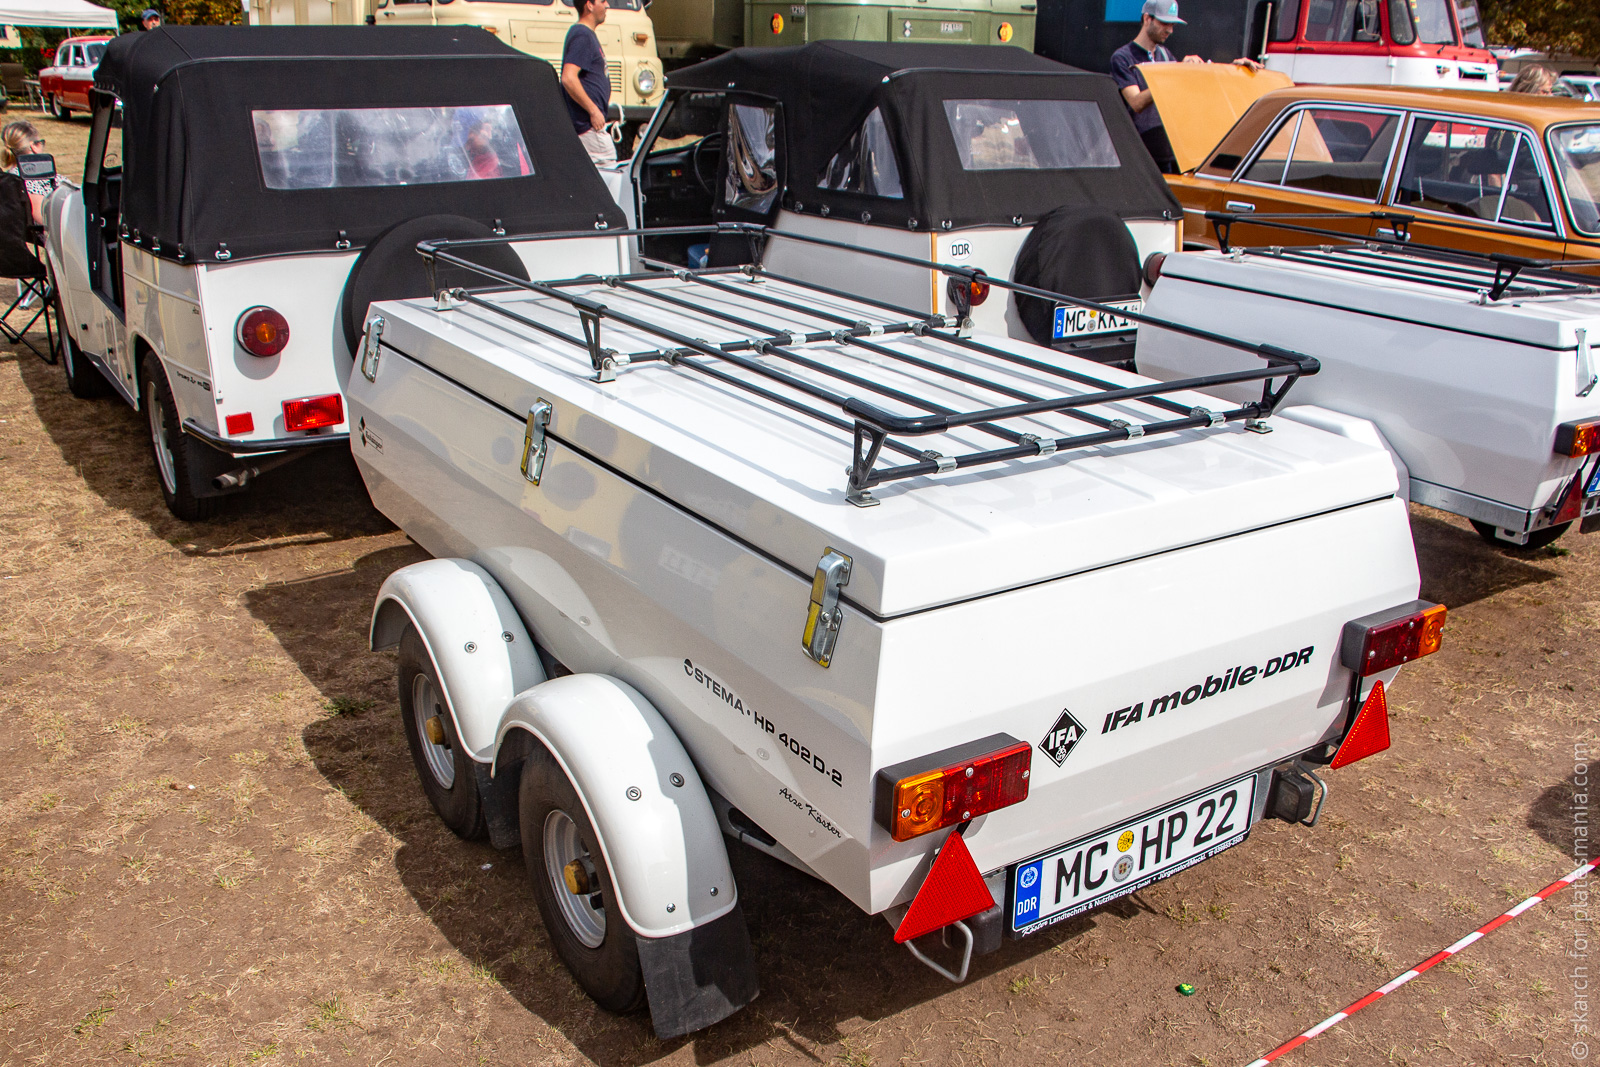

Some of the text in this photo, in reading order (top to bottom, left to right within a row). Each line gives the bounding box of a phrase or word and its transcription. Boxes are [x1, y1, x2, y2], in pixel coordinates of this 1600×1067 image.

[952, 243, 970, 256] DDR
[1065, 310, 1086, 333] MC
[694, 668, 744, 715] STEMA
[754, 711, 775, 734] HP
[1101, 702, 1144, 734] IFA
[1049, 725, 1077, 750] IFA
[805, 803, 841, 838] Köster
[1054, 841, 1109, 904] MC
[1017, 896, 1037, 916] DDR
[1050, 905, 1087, 925] Landtechnik
[1094, 885, 1136, 908] Nutzfahrzeuge
